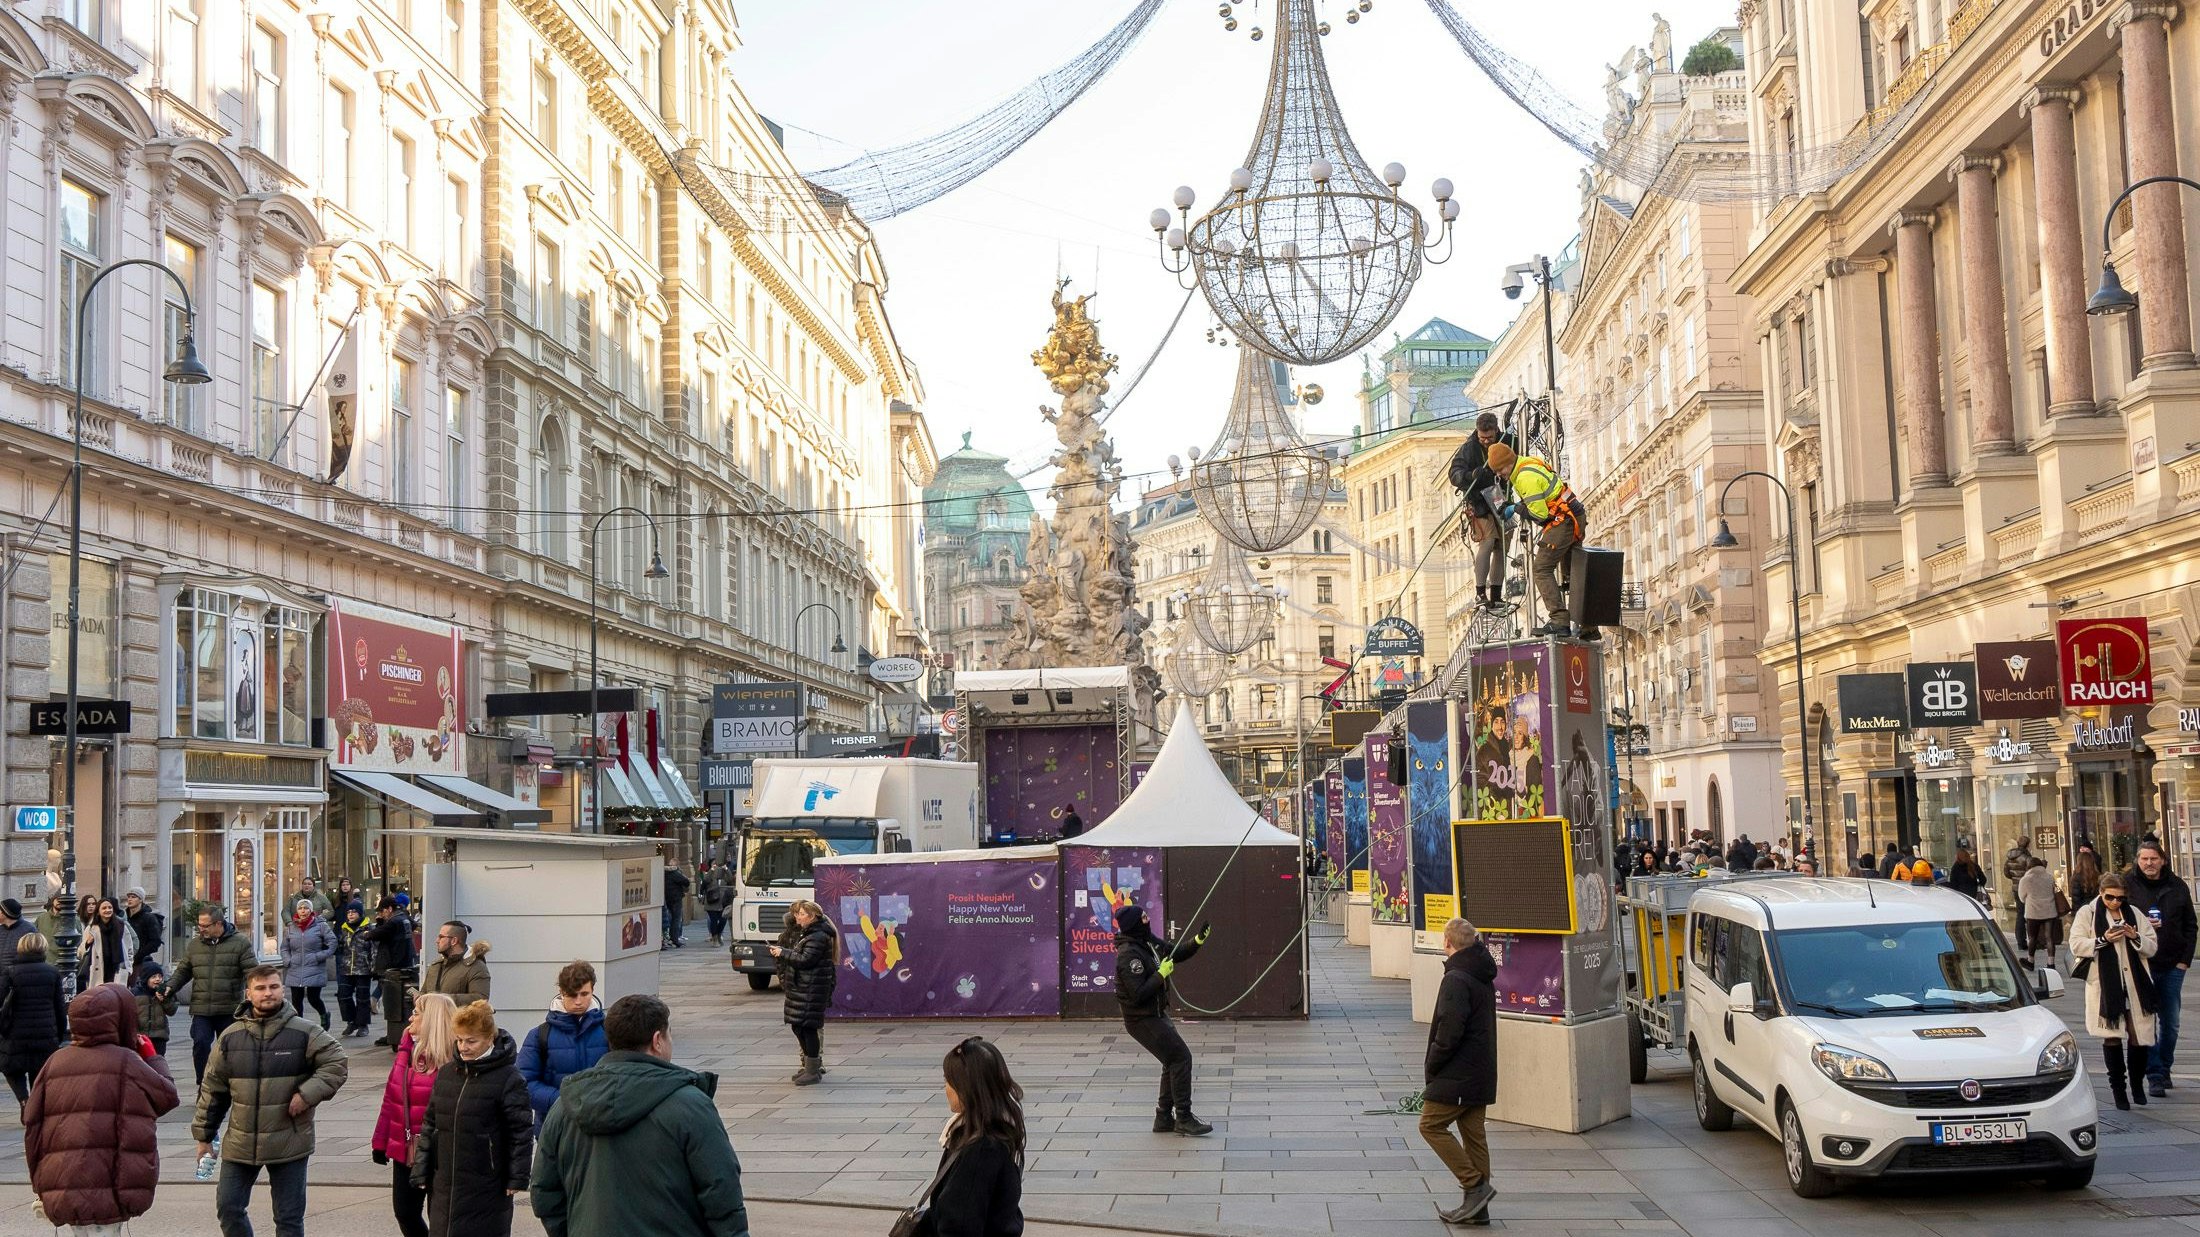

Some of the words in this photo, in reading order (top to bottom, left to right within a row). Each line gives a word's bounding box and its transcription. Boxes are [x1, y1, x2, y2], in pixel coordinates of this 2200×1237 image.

[2041, 0, 2106, 57] GRAB
[53, 612, 105, 635] ESADA
[381, 663, 422, 682] PISCHINGER
[722, 689, 796, 700] wienerin
[1982, 685, 2056, 702] Wellendorff
[2070, 681, 2147, 700] RAUCH
[1849, 717, 1901, 729] MaxMara
[2072, 715, 2134, 748] Wellendorff
[831, 735, 877, 747] HÜBNER
[1561, 759, 1599, 792] TANZ
[1572, 794, 1605, 826] DICH
[24, 812, 40, 825] WC
[948, 893, 974, 902] Prosit
[976, 893, 1015, 903] Neujahr!
[948, 904, 978, 914] Happy
[980, 904, 1000, 912] New
[1002, 903, 1026, 912] Year!
[948, 915, 974, 924] Felice
[975, 915, 999, 923] Anno
[1001, 914, 1034, 923] Nuovo!
[1072, 929, 1115, 941] Wiene
[1584, 953, 1601, 969] 2025
[1965, 1085, 1977, 1096] FIAT
[1944, 1126, 1965, 1141] BL
[1973, 1122, 2023, 1139] 553LY
